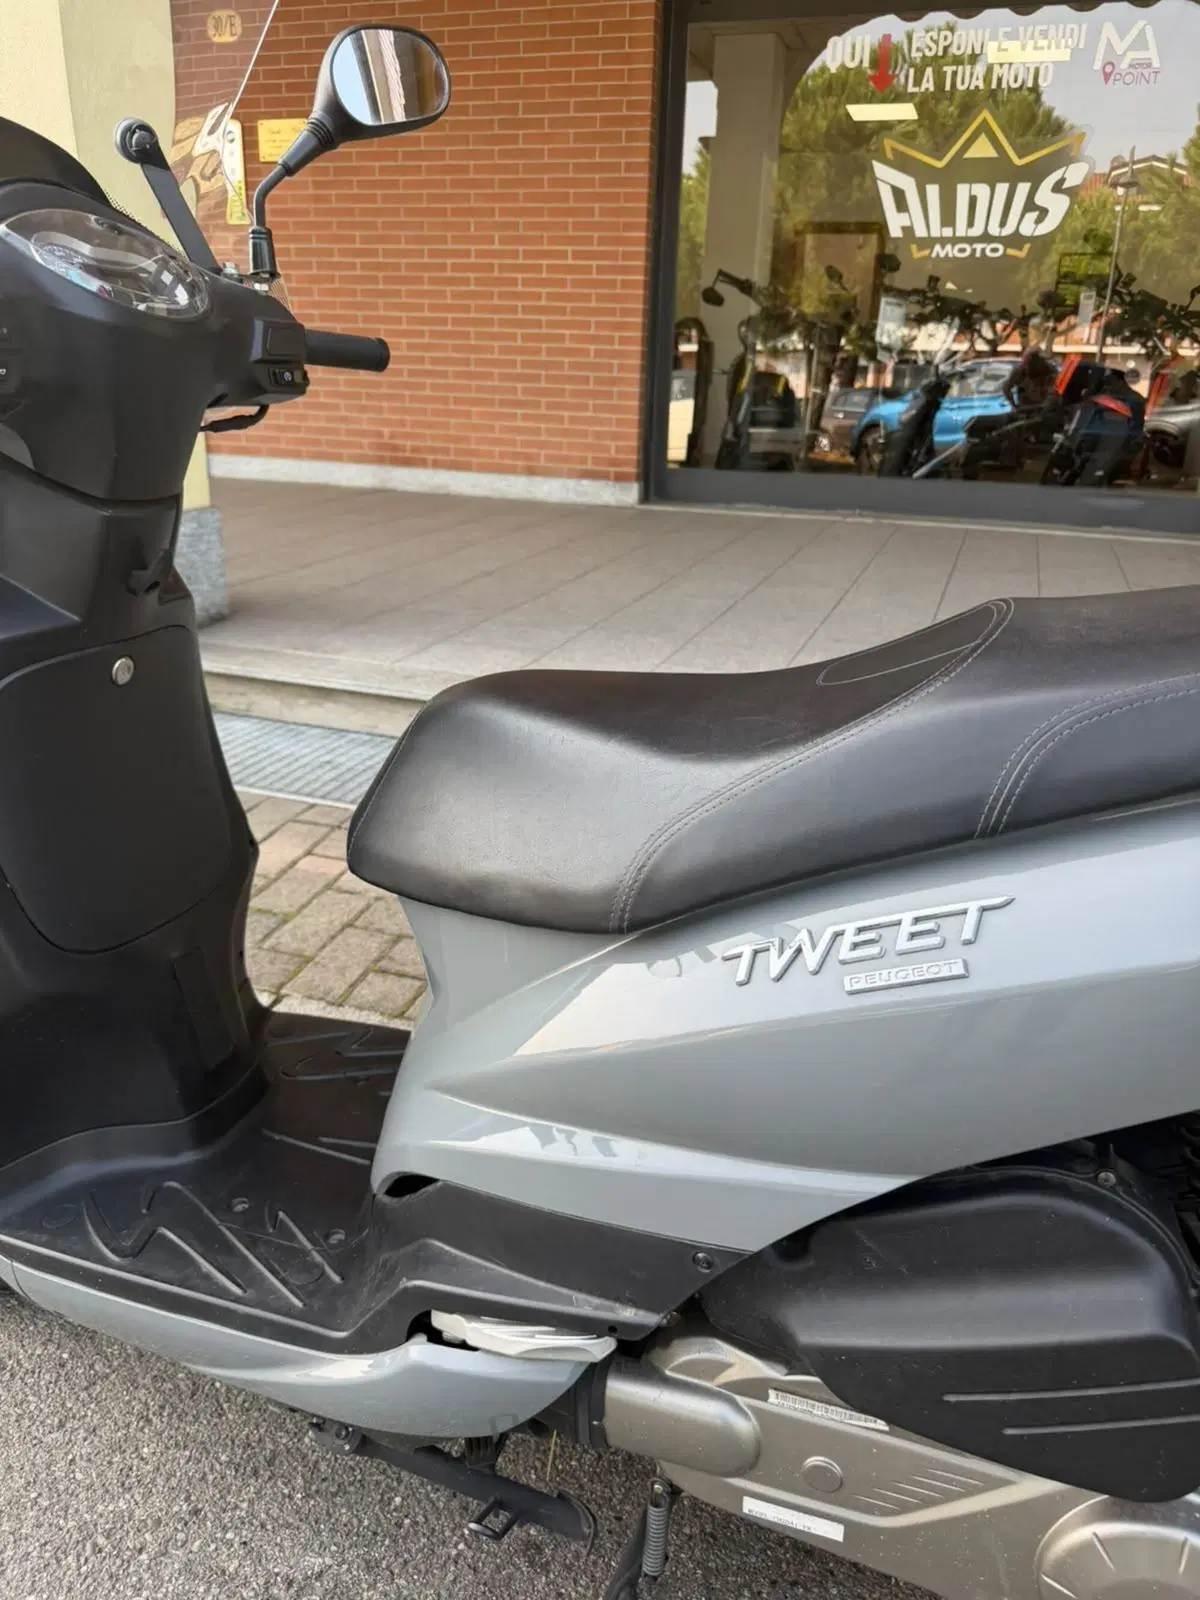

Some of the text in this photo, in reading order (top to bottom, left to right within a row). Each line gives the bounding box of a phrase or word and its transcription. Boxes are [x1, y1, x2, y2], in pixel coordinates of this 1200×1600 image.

[827, 36, 870, 73] QUI
[911, 29, 991, 58] ESPONI
[1017, 23, 1088, 52] VENDI
[907, 62, 1054, 93] LA TUA MOTO
[1112, 70, 1161, 86] POINT
[872, 160, 1090, 238] ALDUS
[931, 243, 1005, 258] MOTO
[721, 894, 1016, 986] TWEET
[849, 961, 960, 988] PEUGEOT
